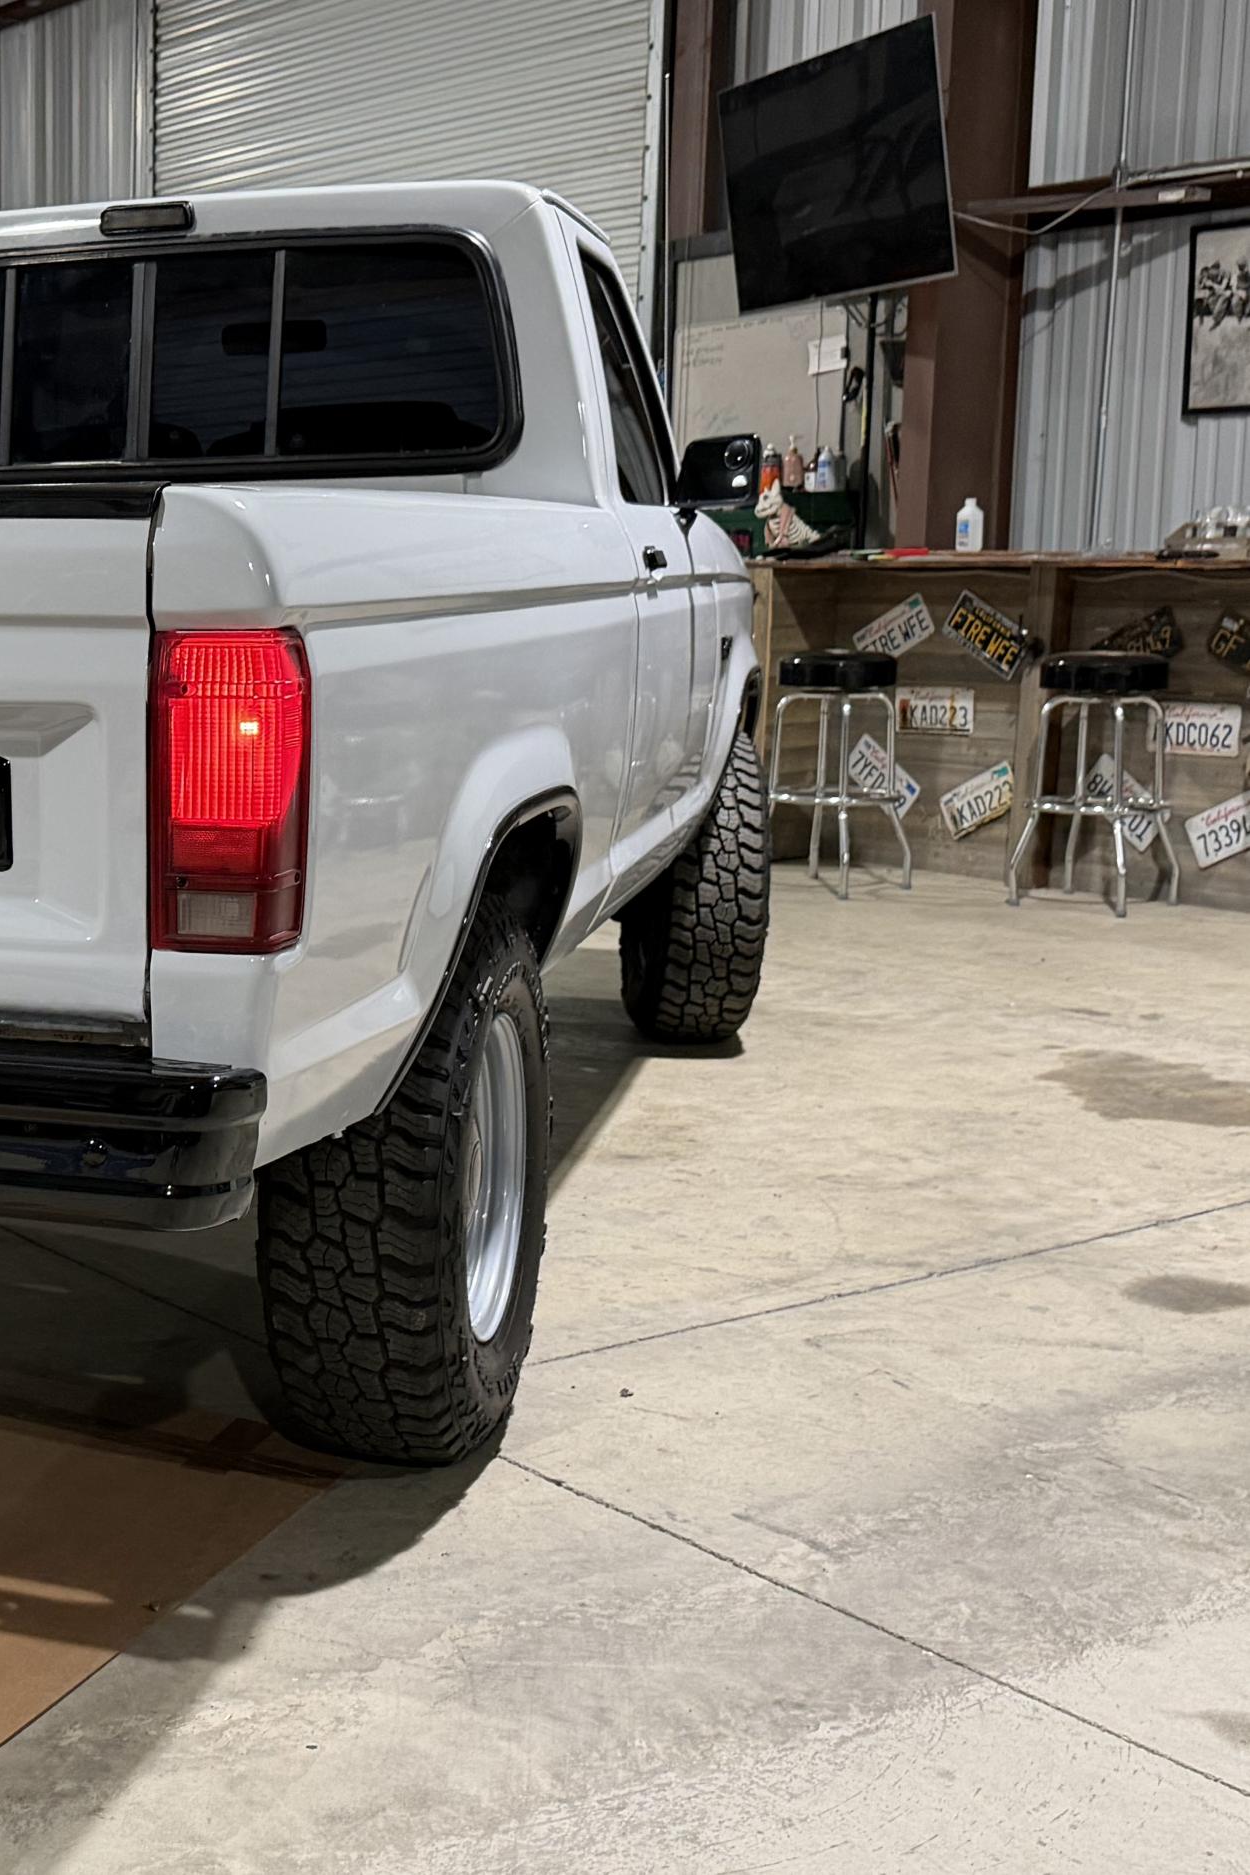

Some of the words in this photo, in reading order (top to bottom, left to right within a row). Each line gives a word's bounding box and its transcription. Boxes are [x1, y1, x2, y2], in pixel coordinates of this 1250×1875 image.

[898, 608, 930, 643] WFE
[950, 607, 992, 648] FIRE
[985, 632, 1021, 673] WFE
